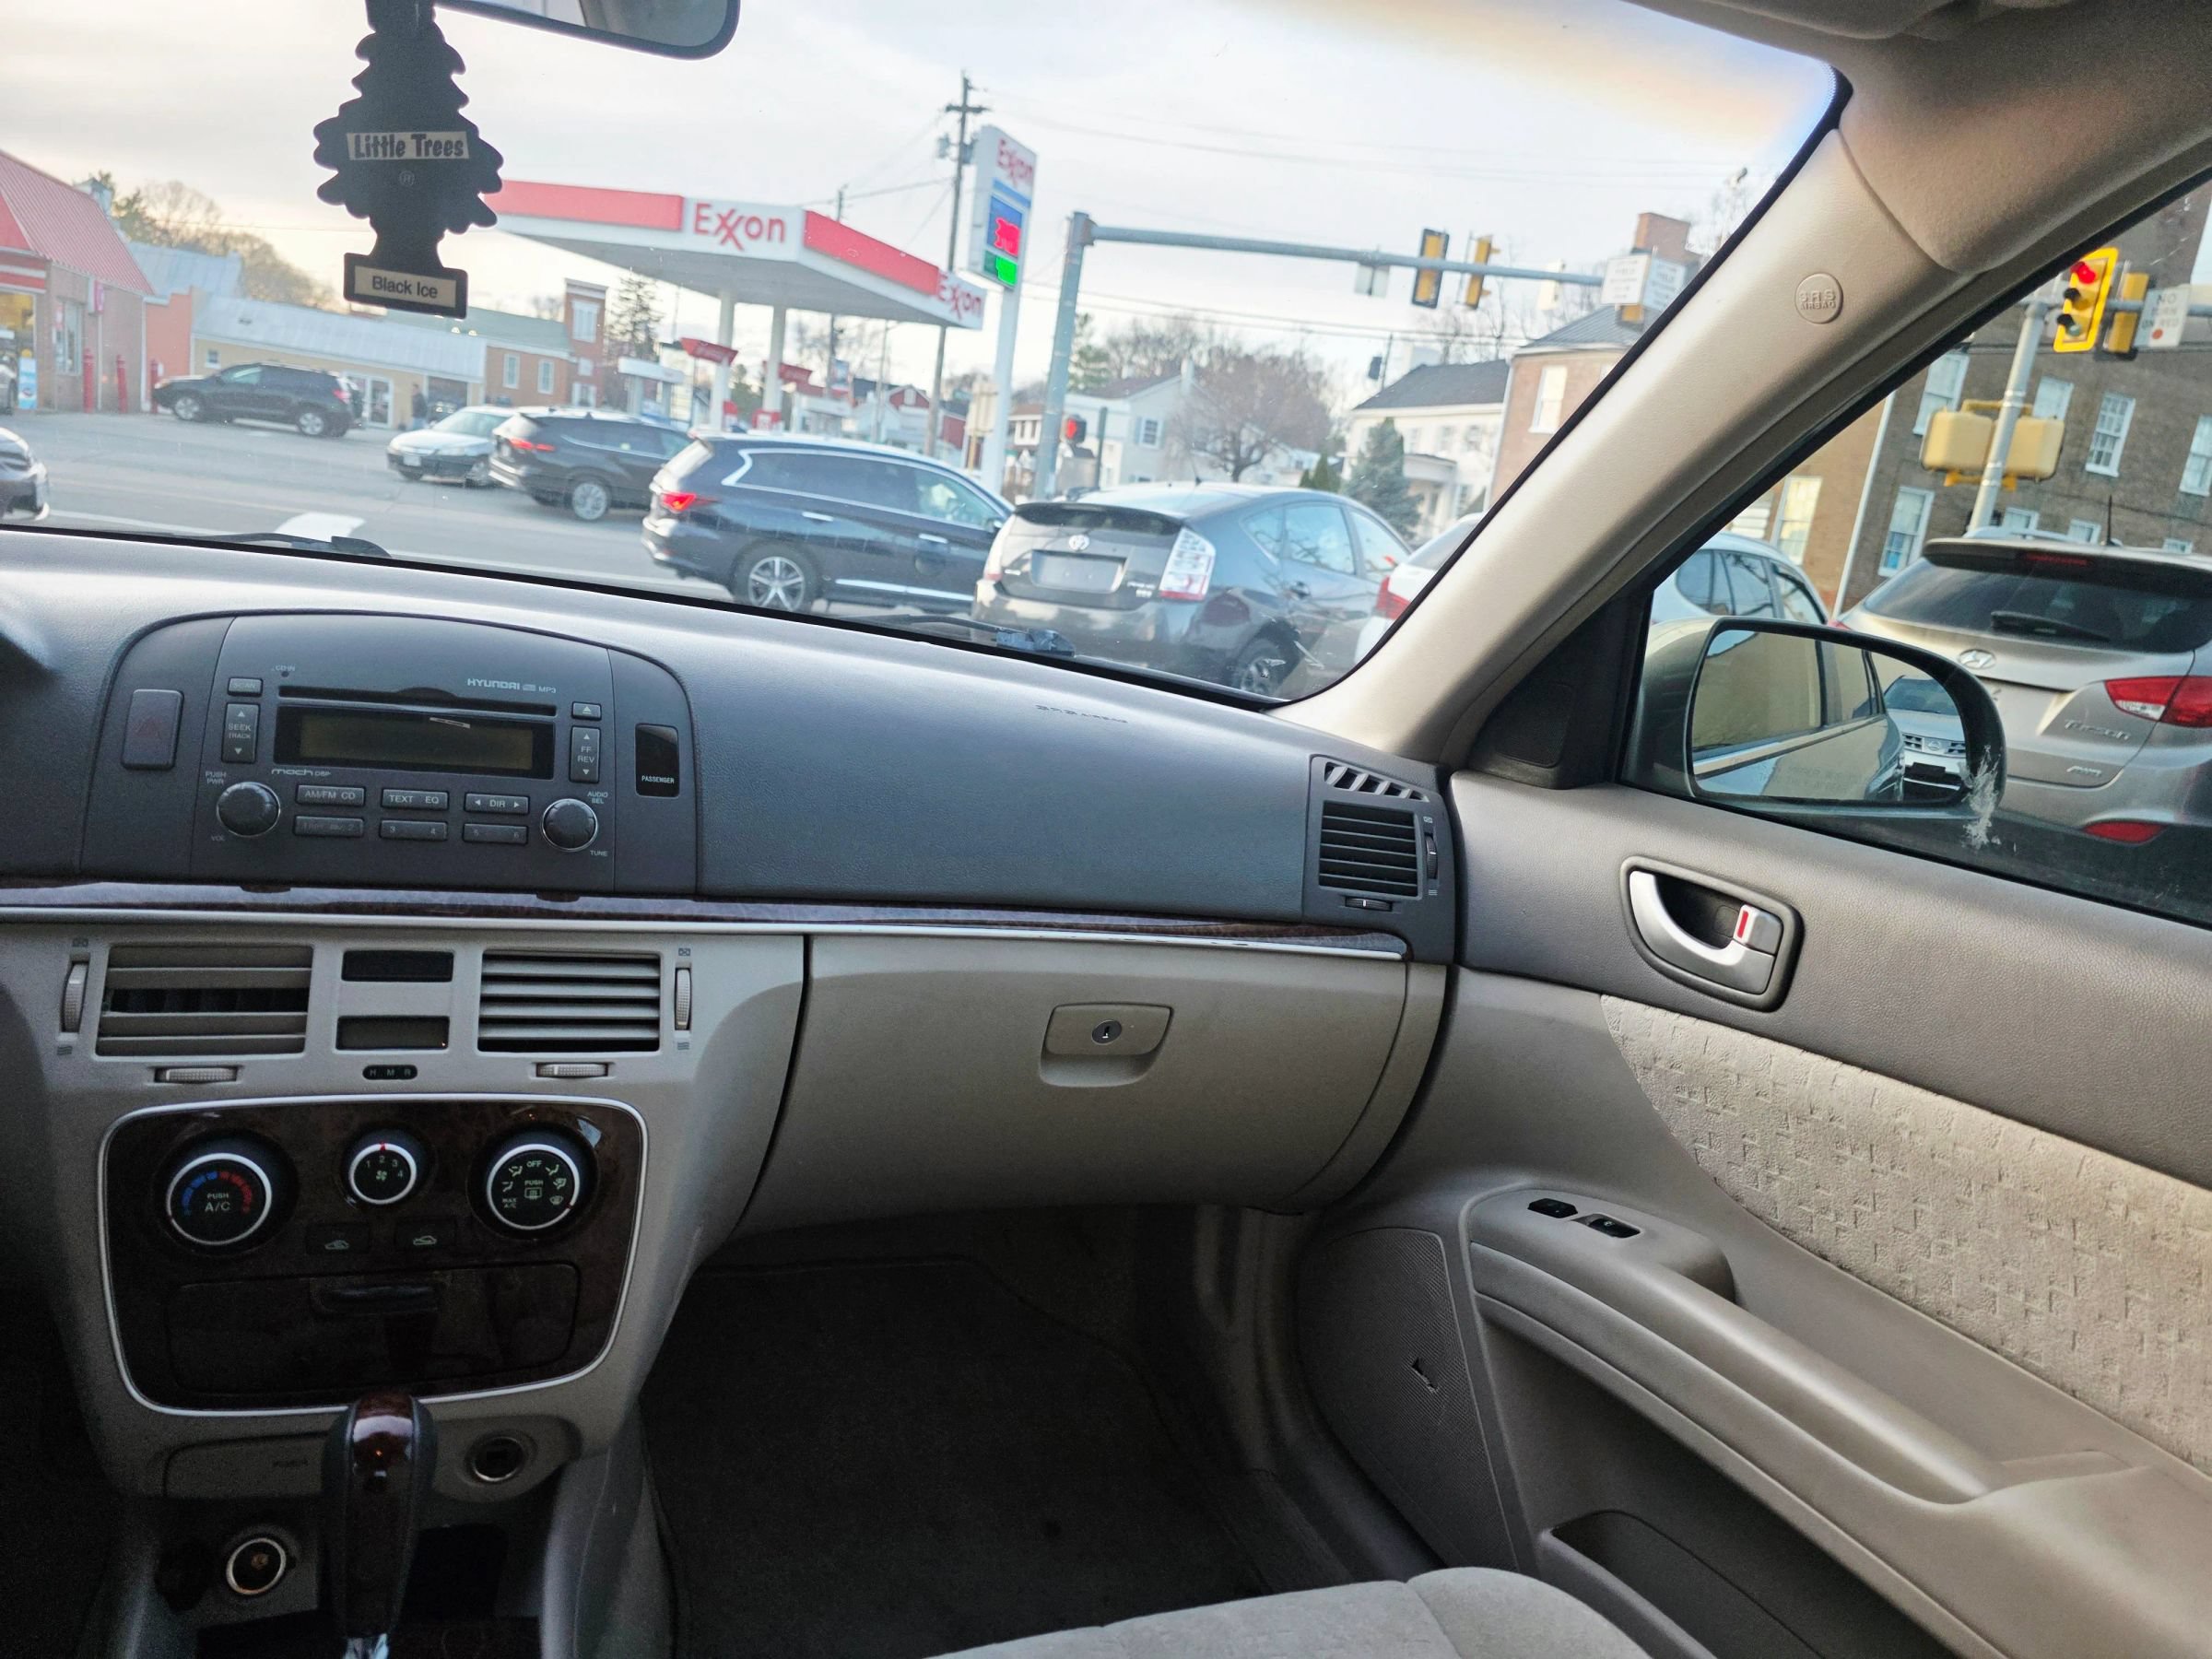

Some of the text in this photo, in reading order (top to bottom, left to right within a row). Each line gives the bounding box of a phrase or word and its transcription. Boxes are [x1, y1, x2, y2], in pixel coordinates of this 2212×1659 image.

[354, 134, 465, 159] Little Trees
[996, 137, 1034, 188] Exxon
[693, 202, 786, 252] Exxon
[371, 276, 438, 299] Black Ice
[937, 273, 983, 322] Exxon
[466, 677, 521, 690] HYUNDAI
[538, 685, 557, 694] MP3
[228, 723, 252, 732] SEEK
[577, 755, 595, 764] REV
[641, 775, 675, 784] PASSENGER
[304, 790, 356, 800] AM/FM CD
[388, 794, 440, 805] TEXT EQ
[489, 799, 506, 808] DIR
[379, 1155, 385, 1163] 2
[392, 1159, 398, 1168] 3
[526, 1159, 543, 1168] OFF
[397, 1171, 404, 1179] 4
[205, 1201, 230, 1212] A/C
